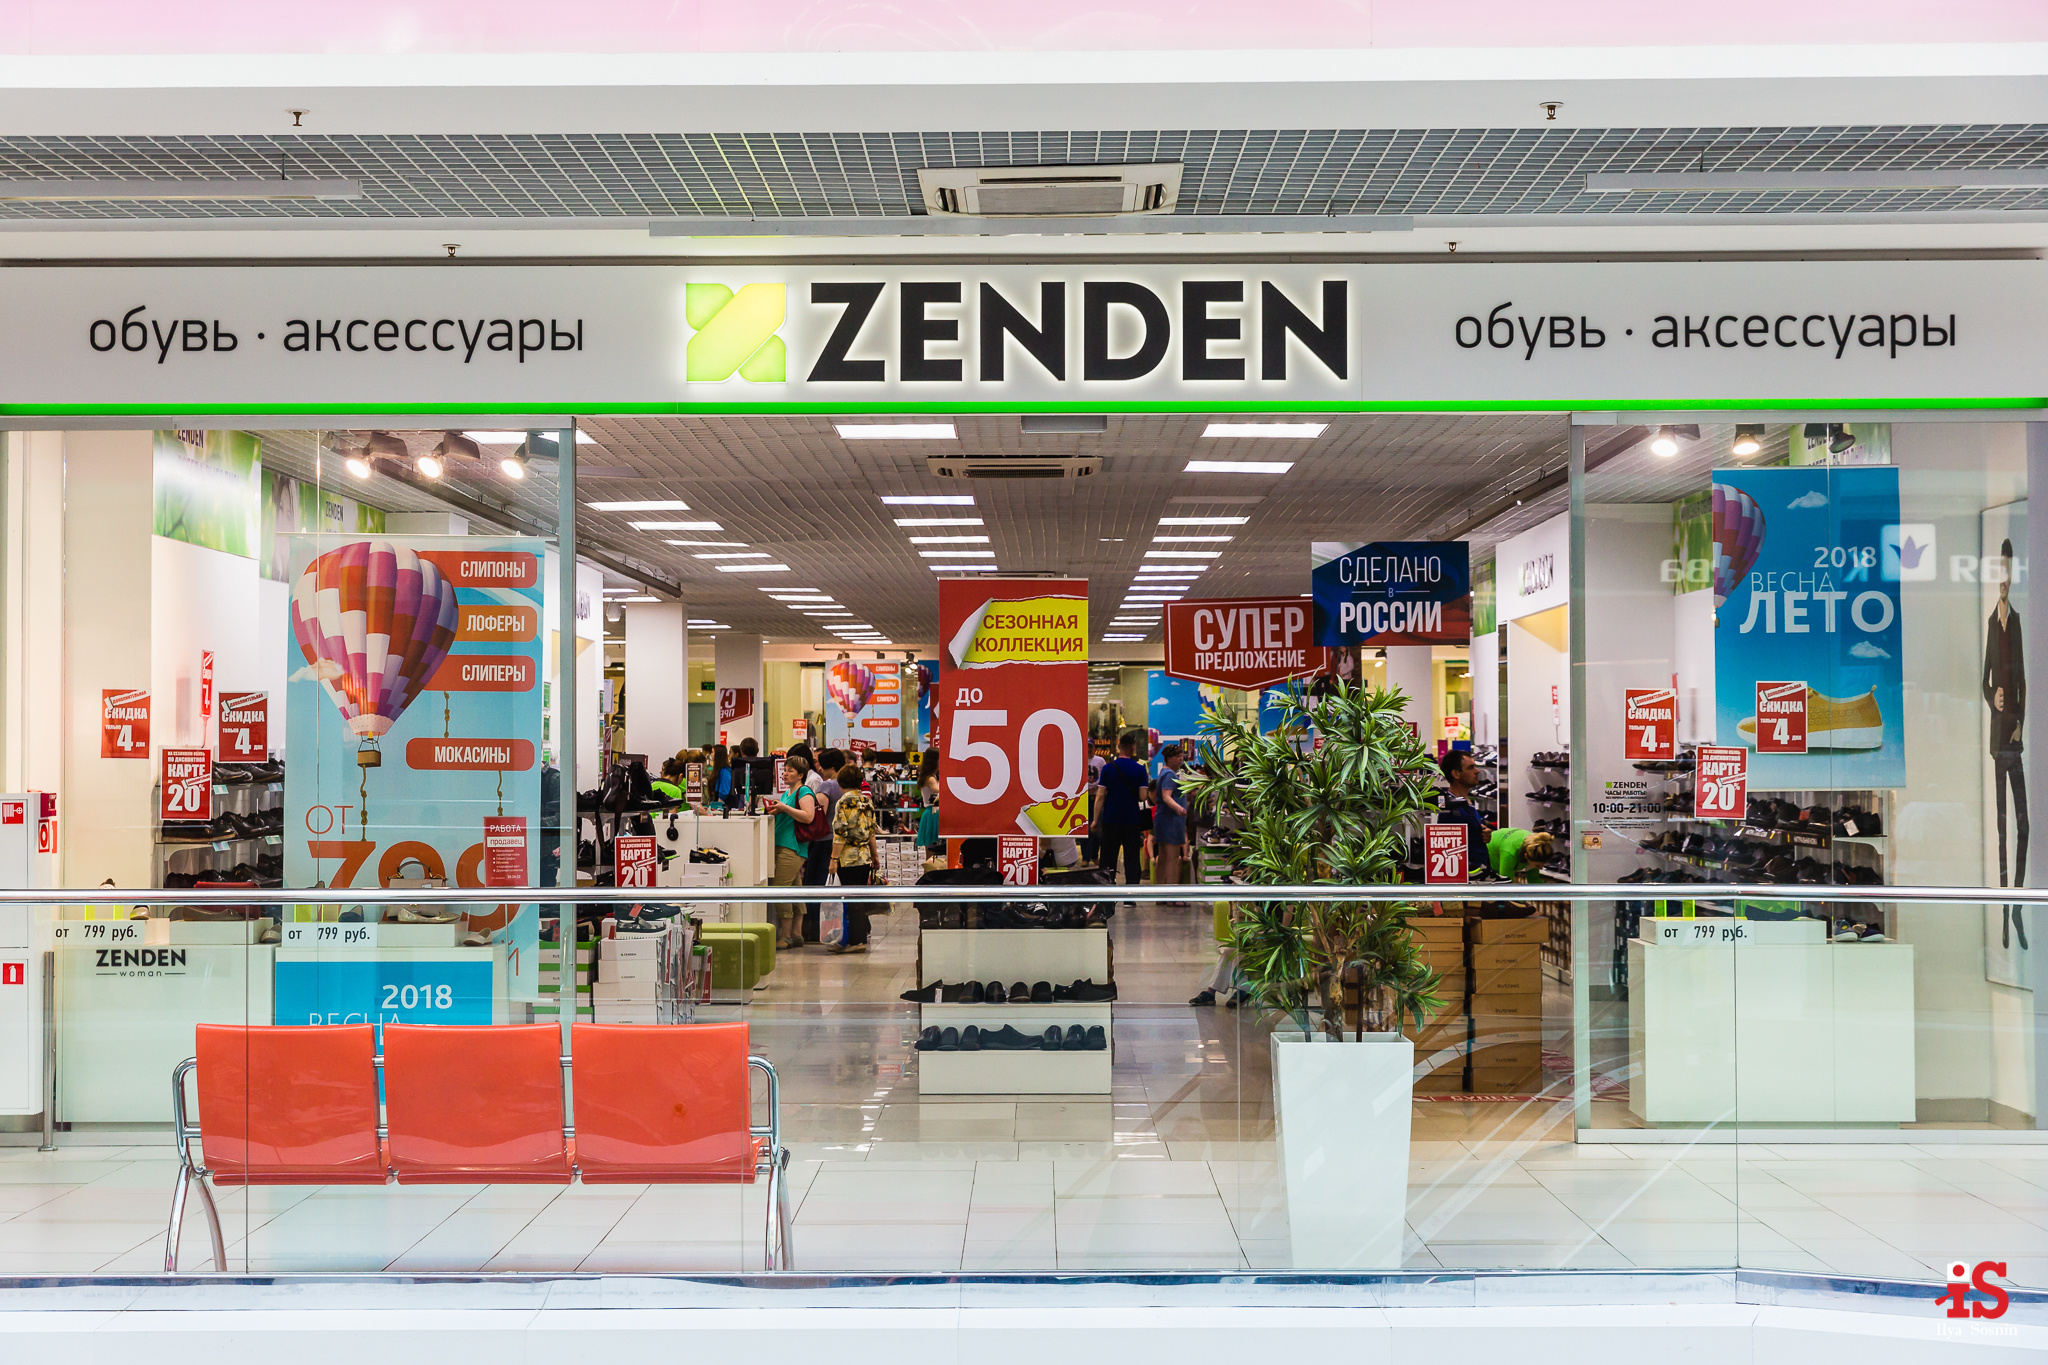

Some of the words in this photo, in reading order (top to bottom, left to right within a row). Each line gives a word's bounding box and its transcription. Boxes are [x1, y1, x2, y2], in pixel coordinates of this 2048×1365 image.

[89, 304, 239, 364] обувь
[283, 318, 583, 363] аксессуары
[806, 281, 1348, 382] ZENDEN
[1455, 301, 1606, 360] обувь
[1652, 313, 1956, 359] аксессуары
[1813, 546, 1877, 568] 2018
[460, 561, 526, 578] СЛИПОНЫ
[1339, 556, 1442, 586] СДЕЛАНО
[1751, 571, 1836, 593] ВЕСНА
[1340, 601, 1442, 633] РОССИИ
[1739, 590, 1894, 634] ЛЕТО
[466, 615, 525, 631] ЛОФЕРЫ
[982, 614, 1078, 629] СЕЗОННАЯ
[1192, 606, 1305, 651] СУПЕР
[974, 637, 1083, 655] КОЛЛЕКЦИЯ
[1195, 650, 1306, 671] ПРЕДЛОЖЕНИЕ
[462, 665, 526, 682] СЛИПЕРЫ
[955, 687, 983, 706] ДО
[104, 708, 147, 721] СКИДКА
[1628, 708, 1672, 721] СКИДКА
[1760, 701, 1804, 714] СКИДКА
[221, 711, 265, 724] СКИДКА
[117, 725, 133, 751] 4
[1641, 725, 1657, 752] 4
[1773, 718, 1790, 745] 4
[234, 728, 251, 754] 4
[434, 746, 510, 763] МОКАСИНЫ
[168, 764, 206, 777] КАРТЕ
[1702, 762, 1741, 775] КАРТЕ
[305, 805, 354, 835] ОТ
[490, 824, 522, 833] РАБОТА
[1430, 837, 1462, 848] КАРТЕ
[620, 849, 652, 860] КАРТЕ
[1002, 847, 1033, 858] КАРТЕ
[55, 928, 69, 938] от
[84, 925, 105, 938] 799
[112, 924, 137, 941] руб.
[288, 929, 302, 940] от
[318, 927, 338, 940] 799
[345, 926, 370, 943] руб.
[1664, 928, 1678, 938] от
[1694, 925, 1715, 939] 799
[1722, 925, 1748, 941] руб.
[95, 949, 187, 967] ZENDEN
[381, 984, 454, 1009] 2018
